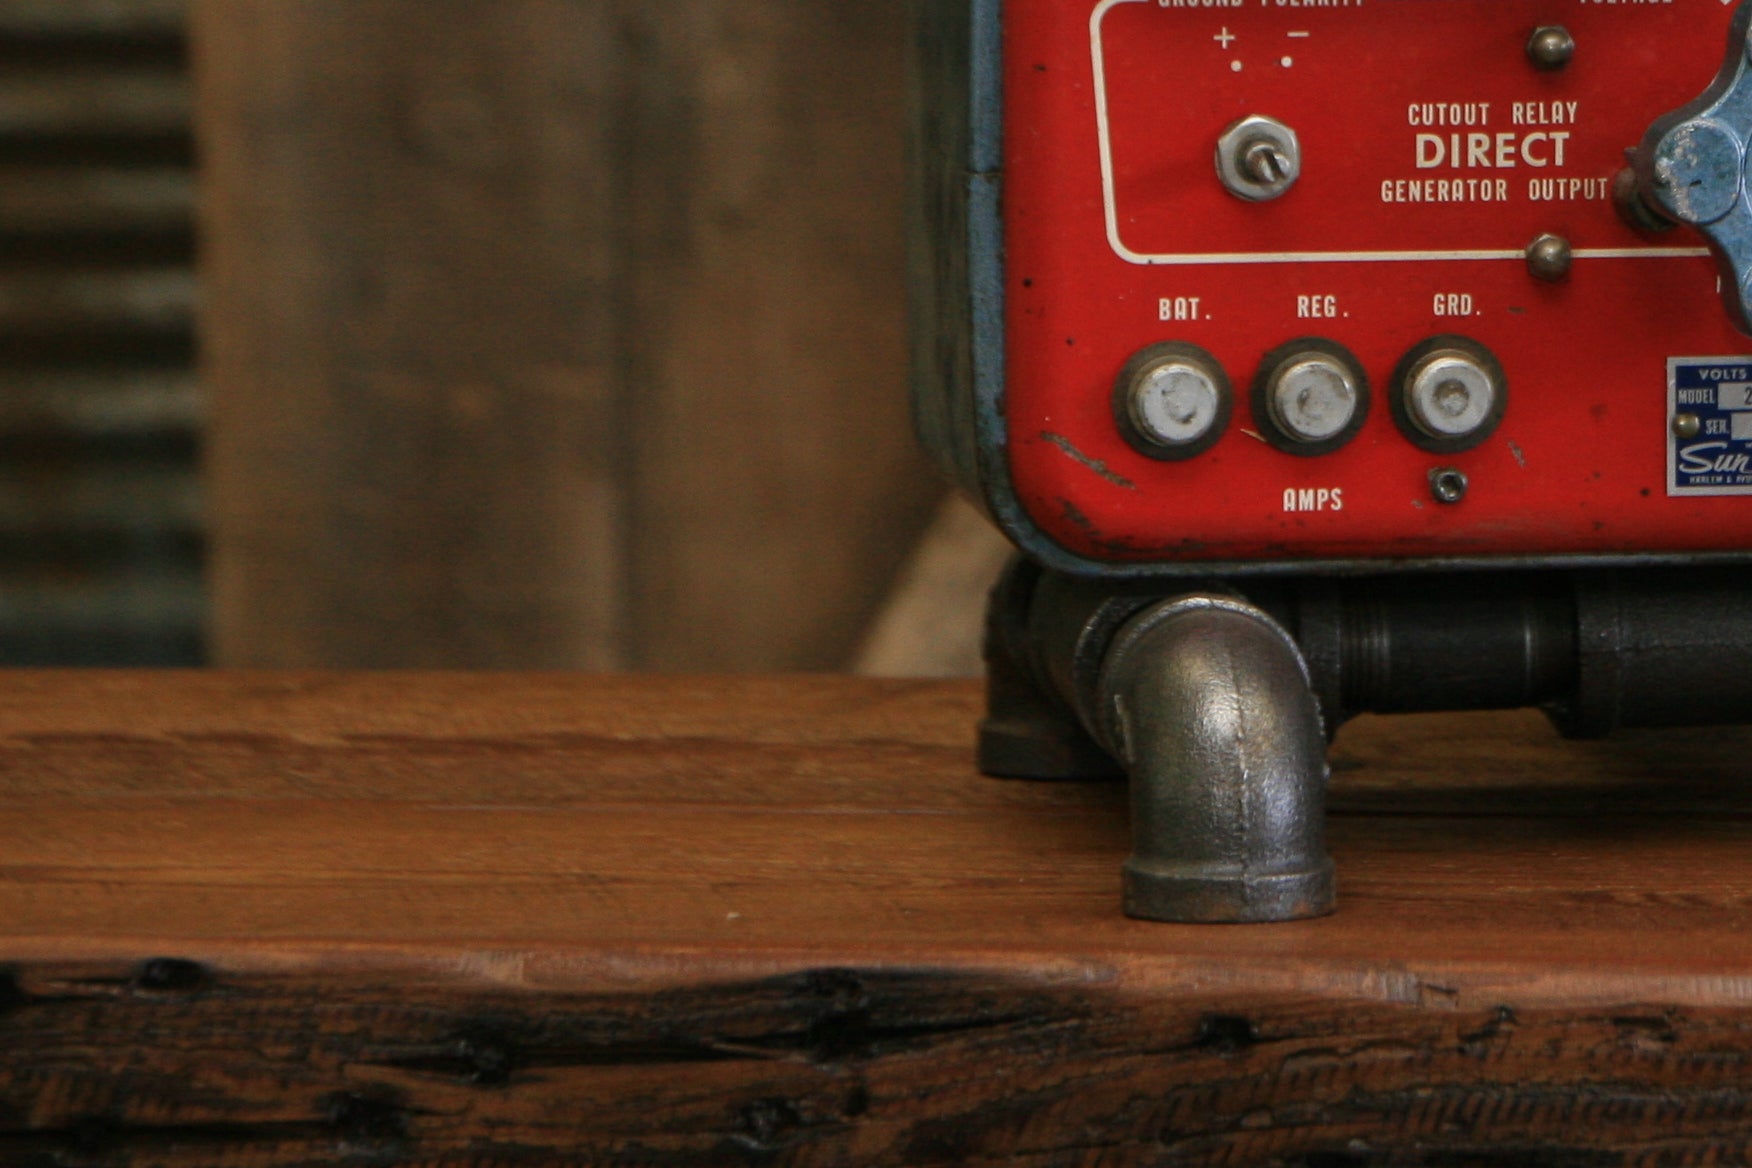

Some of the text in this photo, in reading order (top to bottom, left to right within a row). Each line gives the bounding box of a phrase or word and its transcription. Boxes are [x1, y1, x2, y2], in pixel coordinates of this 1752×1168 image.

[1408, 101, 1578, 126] CUTOUT RELAY
[1416, 131, 1570, 168] DIRECT
[1381, 178, 1608, 203] GENERATOR OUTPUT
[1158, 297, 1212, 320] BAT.
[1297, 295, 1349, 318] REG.
[1433, 293, 1481, 317] GRD.
[1699, 368, 1747, 381] VOLTS
[1678, 388, 1715, 404] MODEL
[1678, 441, 1750, 473] Sun
[1282, 488, 1343, 512] AMPS
